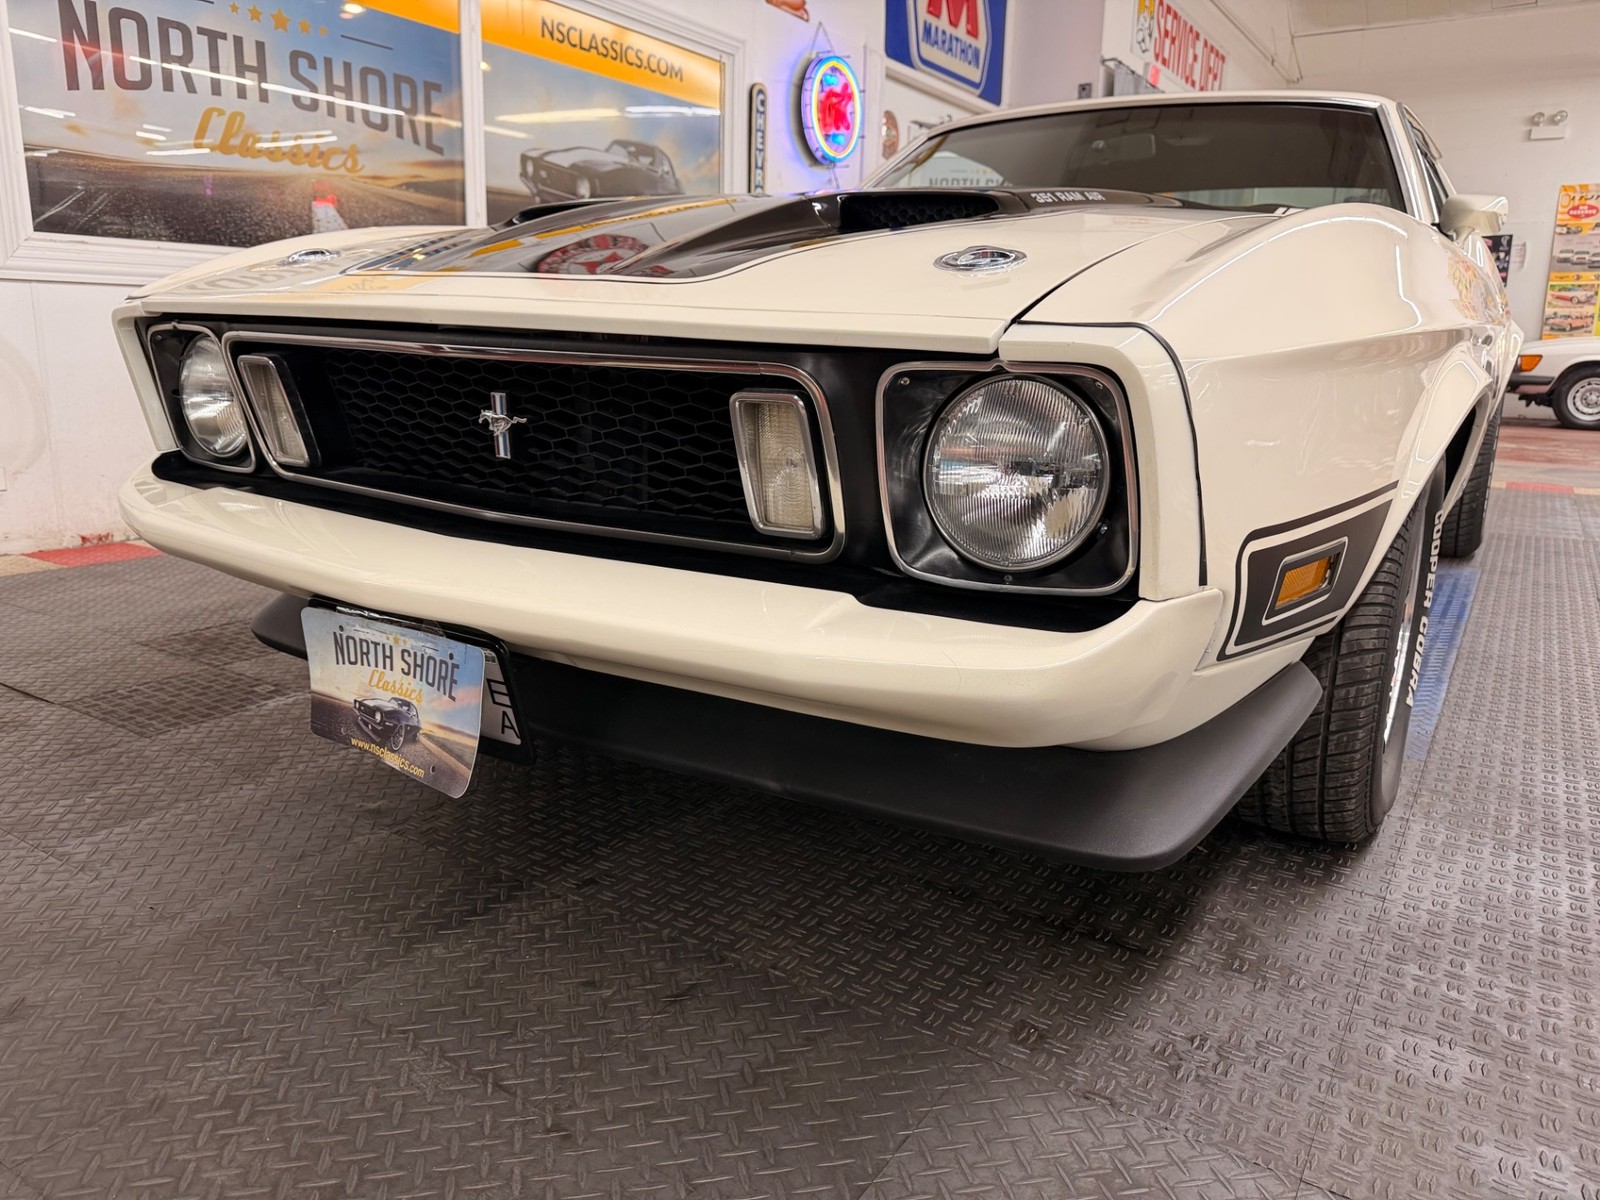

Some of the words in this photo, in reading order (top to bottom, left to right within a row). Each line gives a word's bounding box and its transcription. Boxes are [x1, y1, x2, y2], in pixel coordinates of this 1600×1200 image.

[58, 0, 270, 103] NORTH
[289, 49, 445, 156] SHORE
[541, 15, 684, 82] NSCLASSICS.COM
[922, 19, 982, 70] MARATHON
[1153, 0, 1200, 88] SERVICE
[193, 106, 366, 174] Classics
[1058, 191, 1085, 202] RAM
[1086, 191, 1106, 201] AIR
[1423, 509, 1444, 609] COOPER
[332, 632, 394, 672] NORTH
[400, 648, 460, 702] SHORE
[367, 668, 424, 704] Classics
[1406, 615, 1429, 708] COBRA
[351, 737, 425, 778] www.nsclassics.com
